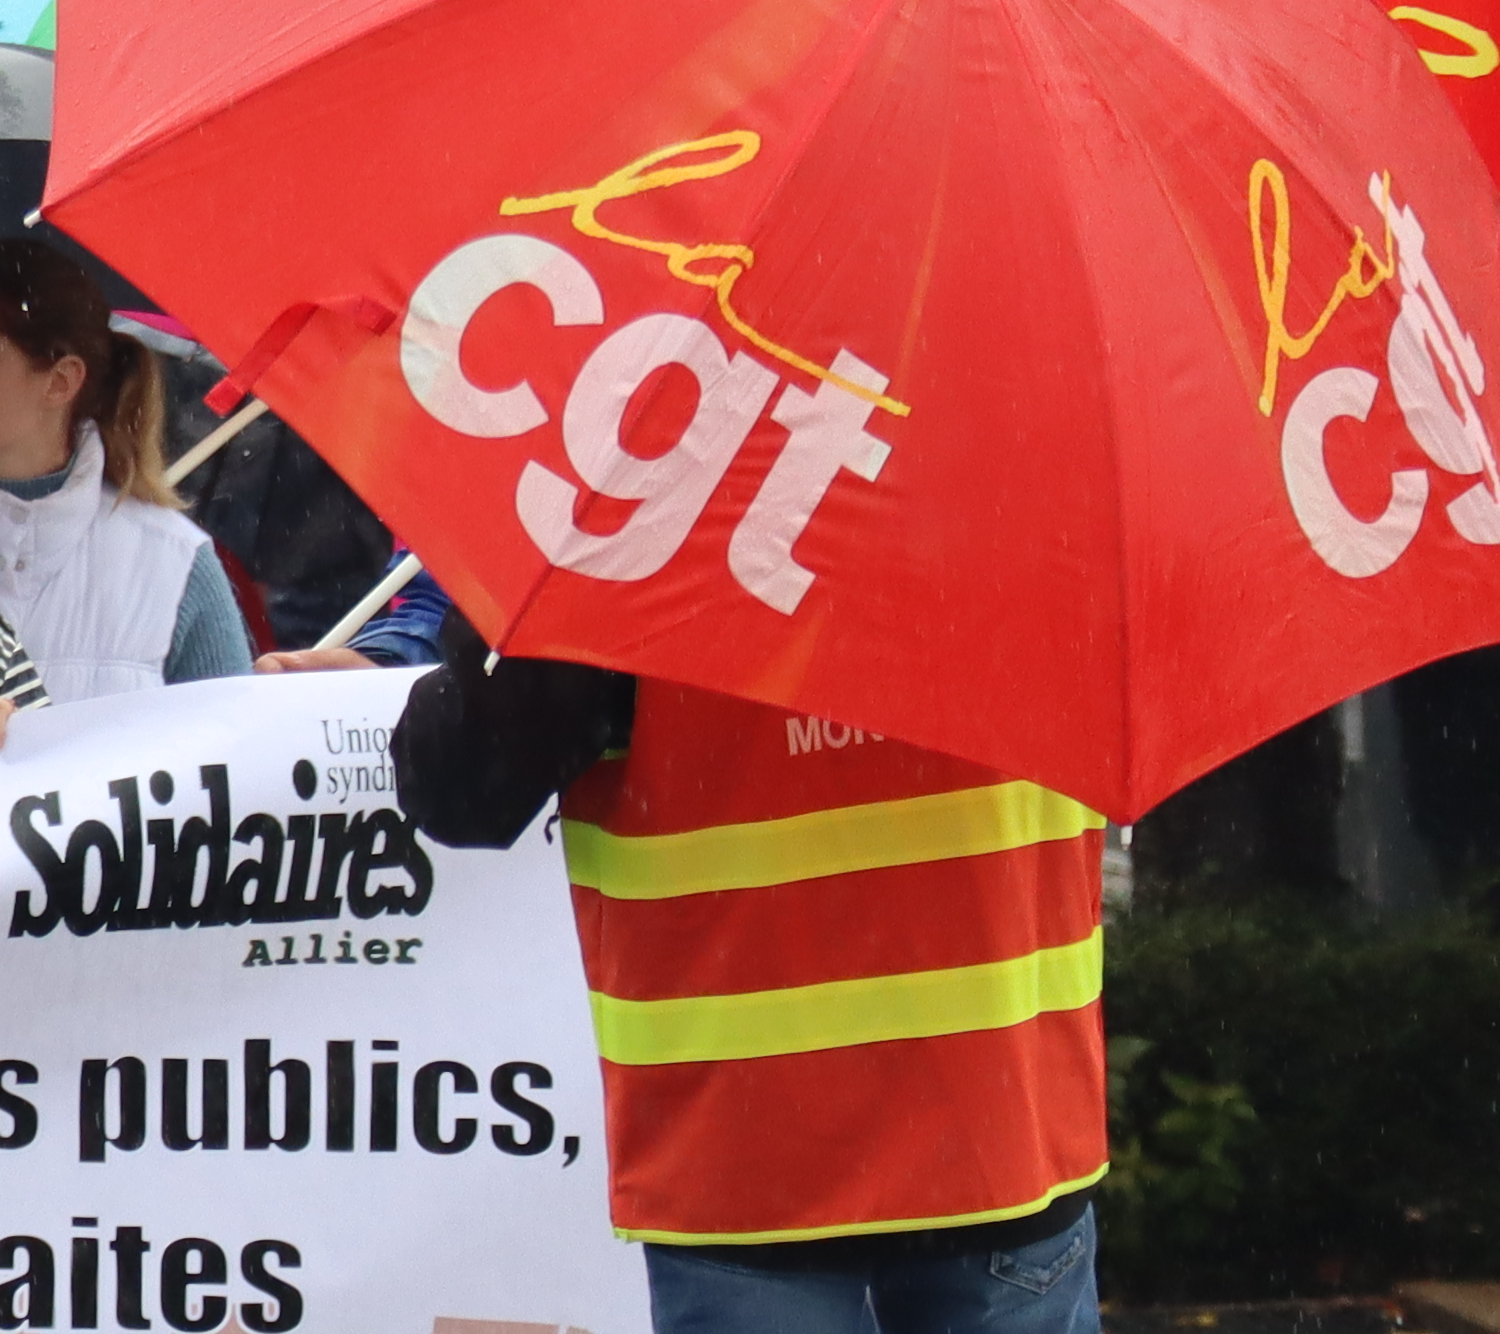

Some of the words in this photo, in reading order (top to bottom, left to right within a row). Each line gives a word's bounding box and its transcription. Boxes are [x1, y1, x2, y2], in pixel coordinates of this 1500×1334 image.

[498, 129, 911, 418] la
[398, 232, 892, 615] cgt
[8, 758, 433, 941] Solidaires
[243, 931, 422, 965] Allier
[79, 1038, 582, 1167] publics,
